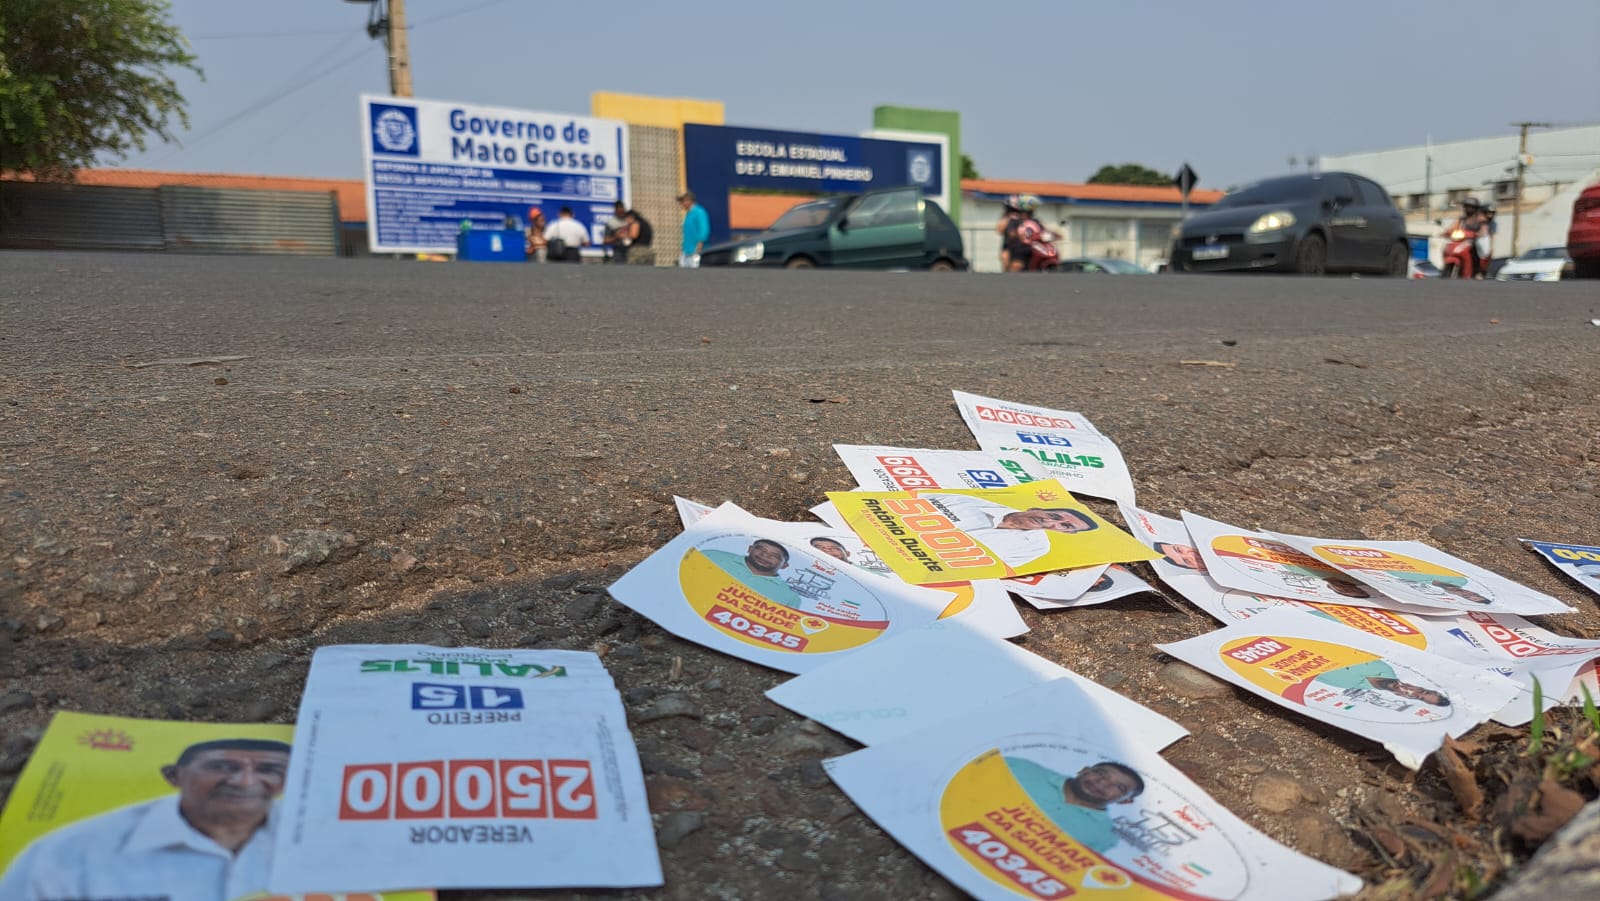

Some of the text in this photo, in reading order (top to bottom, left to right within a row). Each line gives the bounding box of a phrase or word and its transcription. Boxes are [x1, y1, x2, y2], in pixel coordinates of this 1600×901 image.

[449, 109, 590, 144] Governo de
[452, 137, 606, 170] Mato Grosso
[736, 141, 847, 162] ESCOLA ESTADUAL
[979, 408, 1073, 428] 40999
[1022, 434, 1069, 446] 15
[861, 498, 906, 536] Antônio
[899, 538, 943, 572] Duarte
[883, 498, 996, 568] 50011
[716, 592, 796, 629] DA SAÚDE
[721, 586, 801, 622] JUCIMAR
[712, 610, 801, 649] 40345
[360, 658, 568, 679] KALIL15
[1231, 640, 1282, 662] 40345
[416, 685, 522, 708] 15
[428, 711, 522, 725] PREFEITO
[345, 766, 594, 813] 25000
[410, 826, 533, 844] VEREADOR
[985, 811, 1079, 874] DA SAÚDE
[1001, 807, 1095, 868] JUCIMAR
[962, 830, 1067, 896] 40345
